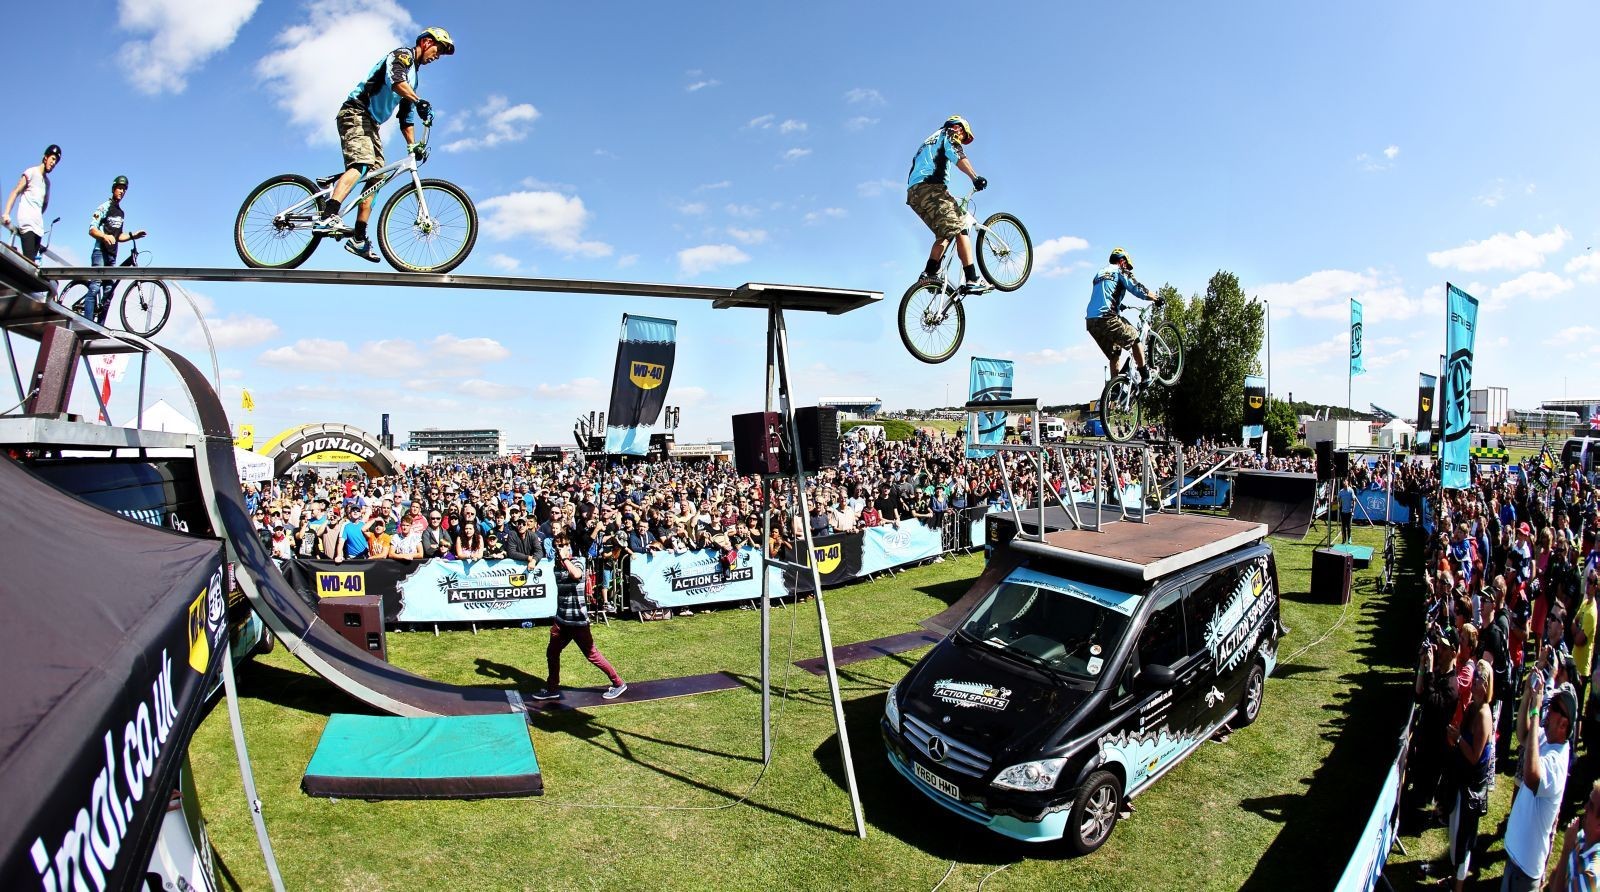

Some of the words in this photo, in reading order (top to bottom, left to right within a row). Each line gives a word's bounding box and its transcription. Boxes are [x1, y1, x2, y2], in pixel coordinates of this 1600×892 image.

[633, 363, 663, 380] WD-40
[301, 437, 375, 459] DUNLOP
[319, 574, 362, 592] WD-40
[675, 576, 712, 589] ACTION
[451, 589, 495, 600] ACTION
[496, 586, 544, 598] SPORTS
[1220, 616, 1250, 664] ACTION
[1248, 584, 1273, 628] SPORTS
[937, 688, 969, 699] ACTION
[968, 693, 1006, 708] SPORTS
[915, 763, 937, 786] YR60
[938, 778, 958, 797] HMD
